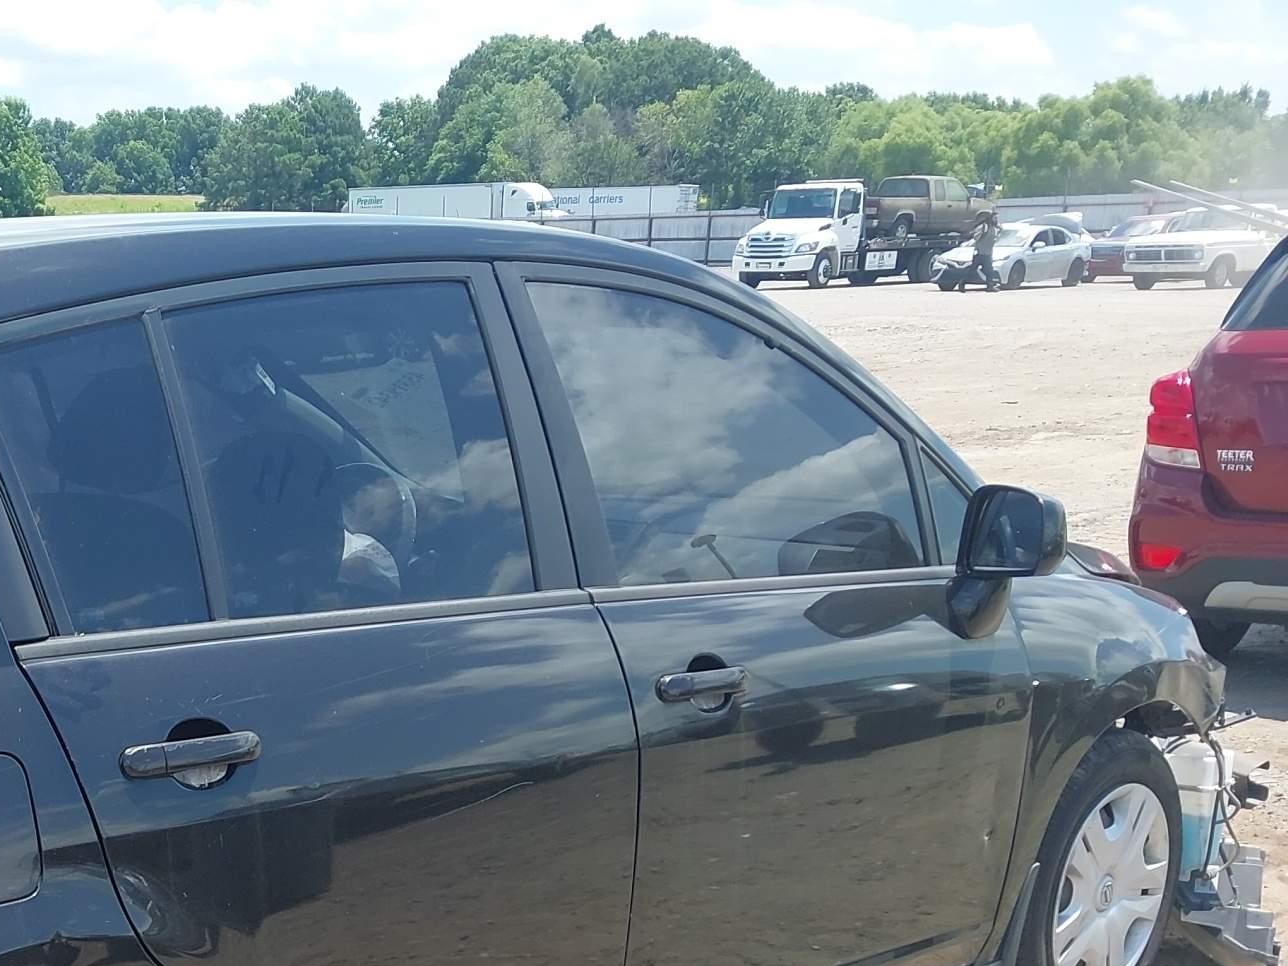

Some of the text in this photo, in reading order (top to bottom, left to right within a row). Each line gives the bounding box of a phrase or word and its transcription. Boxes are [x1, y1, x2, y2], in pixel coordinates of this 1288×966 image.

[357, 195, 384, 205] Premier
[588, 194, 623, 204] carriers
[1216, 449, 1254, 461] TEETER
[1221, 463, 1252, 471] TRAX
